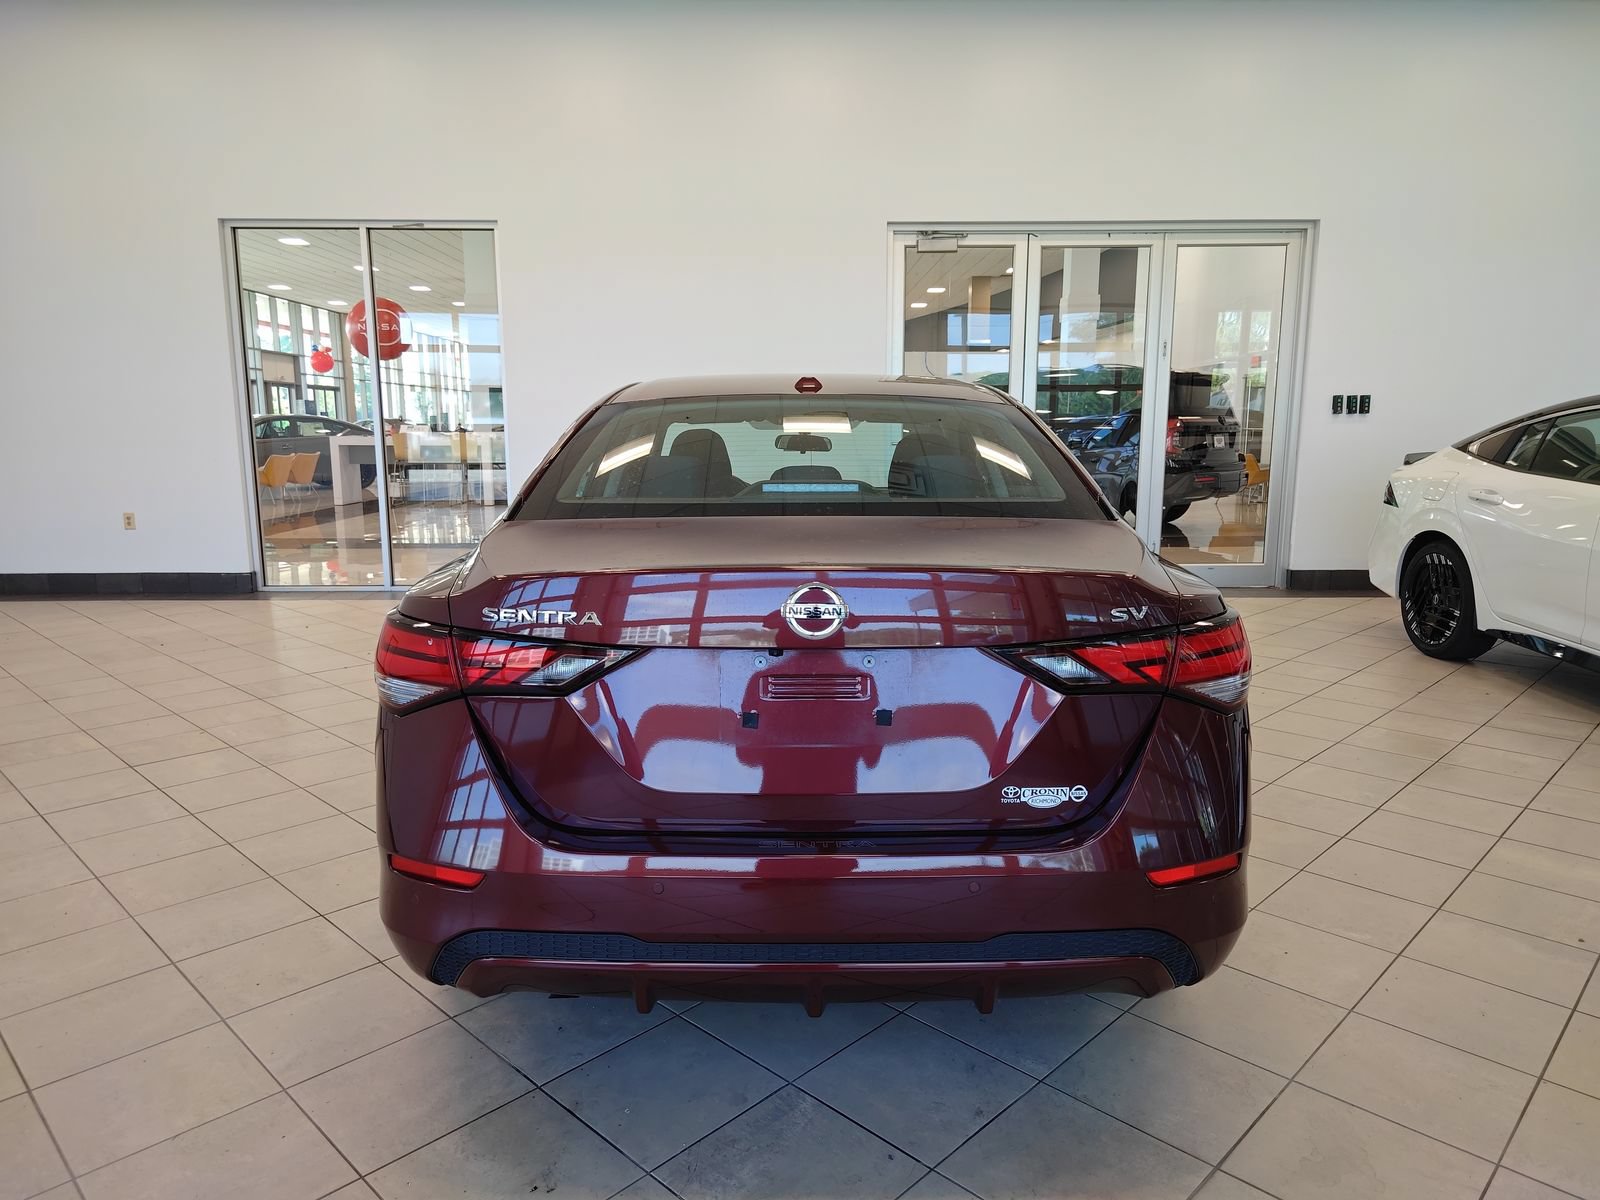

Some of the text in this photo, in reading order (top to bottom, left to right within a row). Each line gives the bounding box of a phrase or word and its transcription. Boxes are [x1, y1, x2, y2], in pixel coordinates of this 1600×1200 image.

[482, 607, 602, 625] SENTRA
[788, 606, 842, 617] NISSAN
[1110, 606, 1148, 622] SV
[1022, 788, 1068, 798] CRONIN
[758, 840, 877, 848] SENTRA
